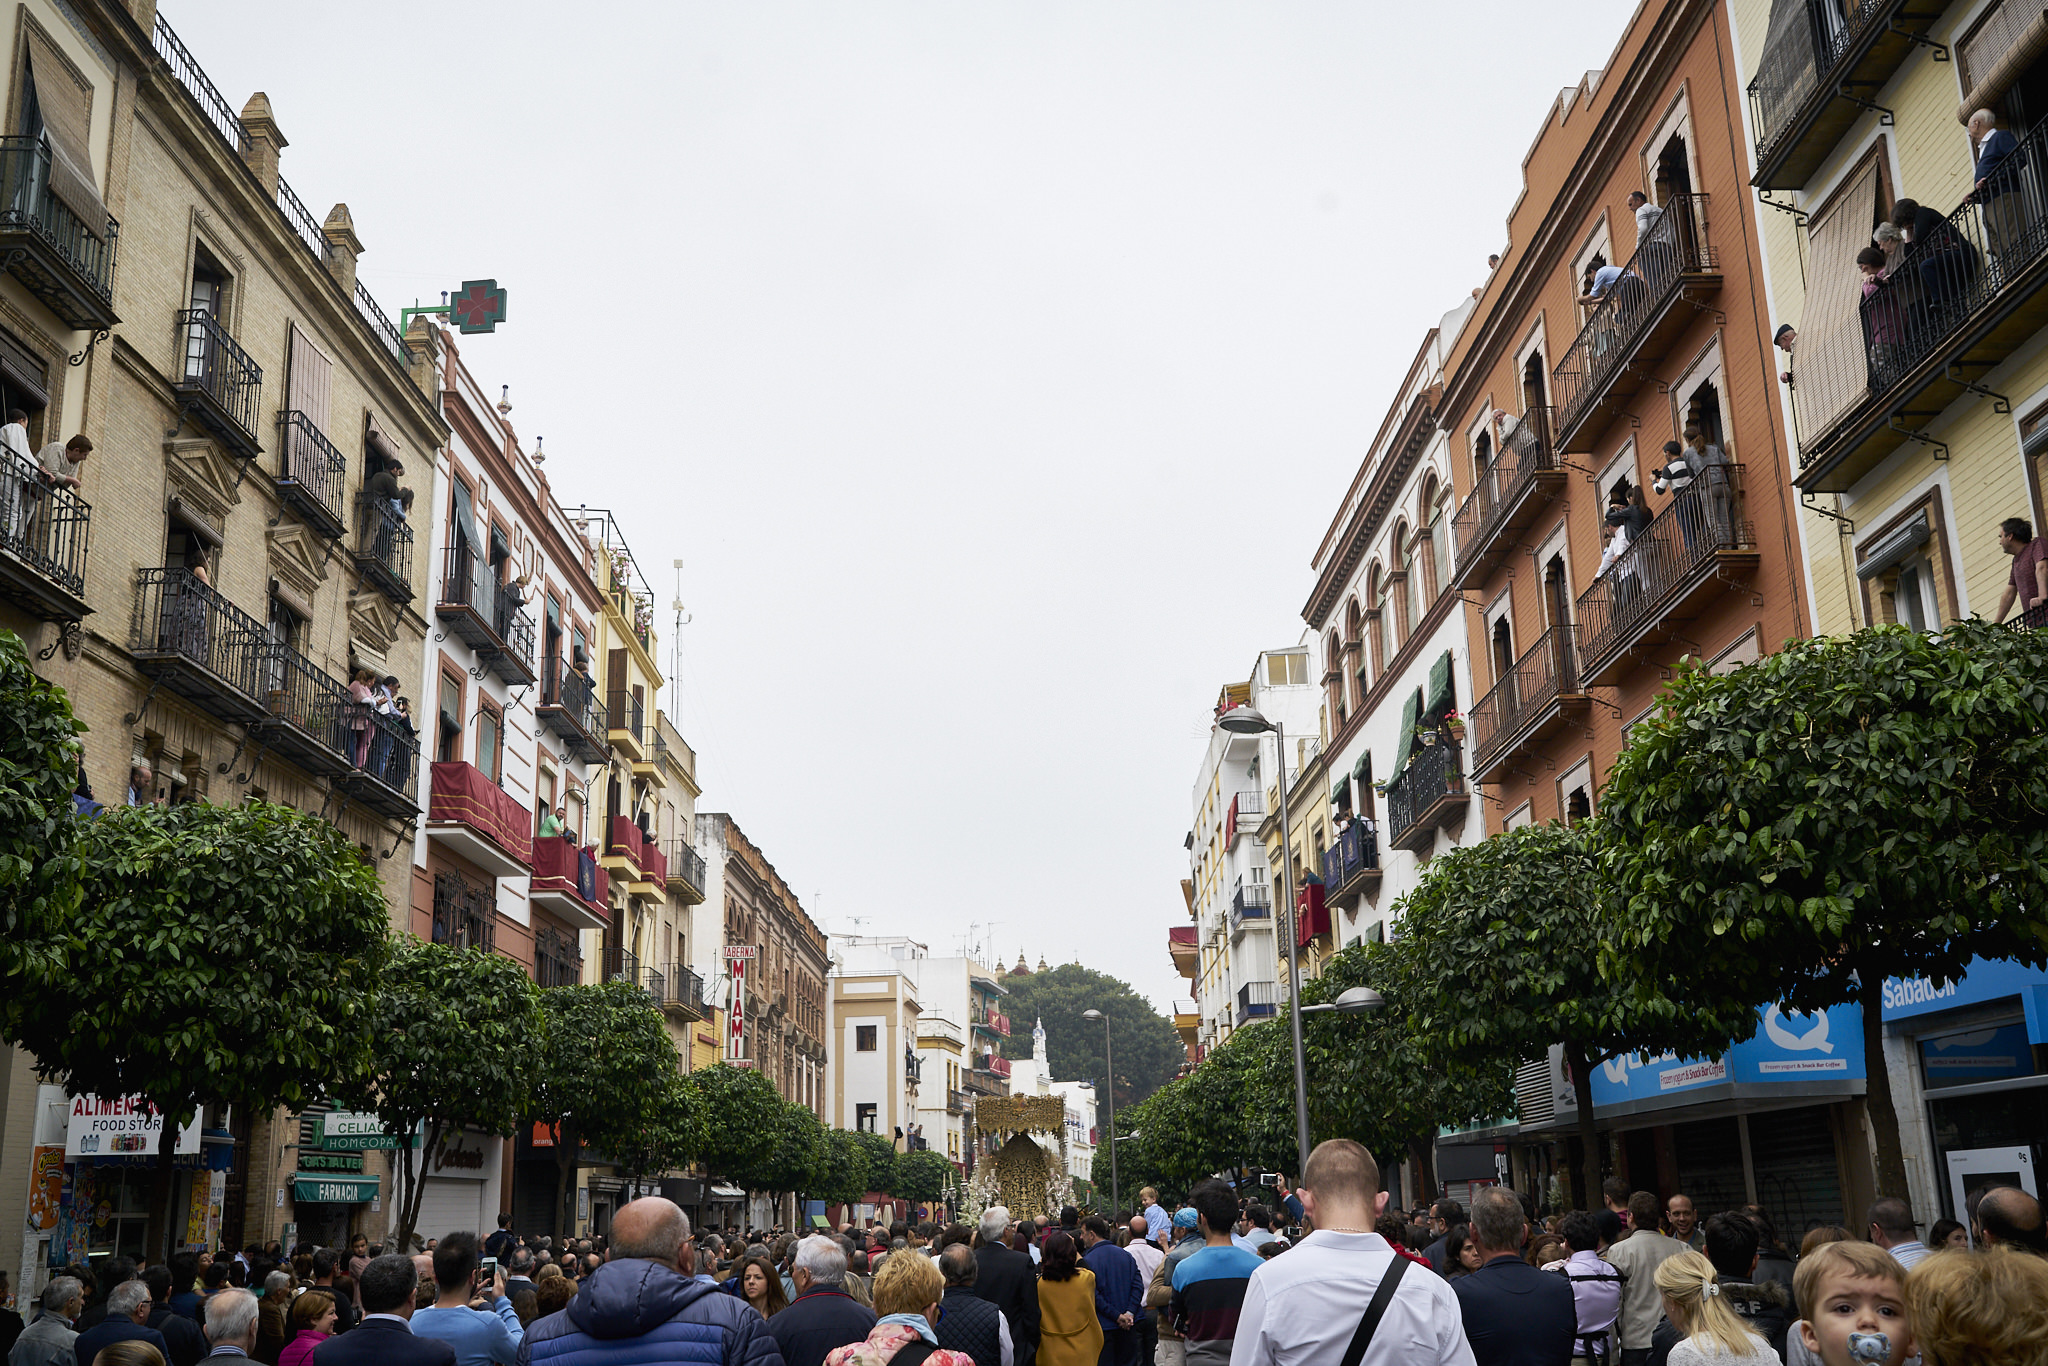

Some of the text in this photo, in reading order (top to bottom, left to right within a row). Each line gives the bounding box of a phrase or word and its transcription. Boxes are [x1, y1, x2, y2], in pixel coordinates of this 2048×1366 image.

[724, 946, 755, 958] TABERNA
[732, 960, 744, 1058] MIAMI
[1689, 1066, 1701, 1080] Snack
[1709, 1064, 1725, 1077] Coffee
[93, 1119, 161, 1131] FOOD STOR
[338, 1122, 385, 1134] CELIAC
[329, 1137, 398, 1149] HOMEOPA
[319, 1183, 358, 1201] FARMACIA
